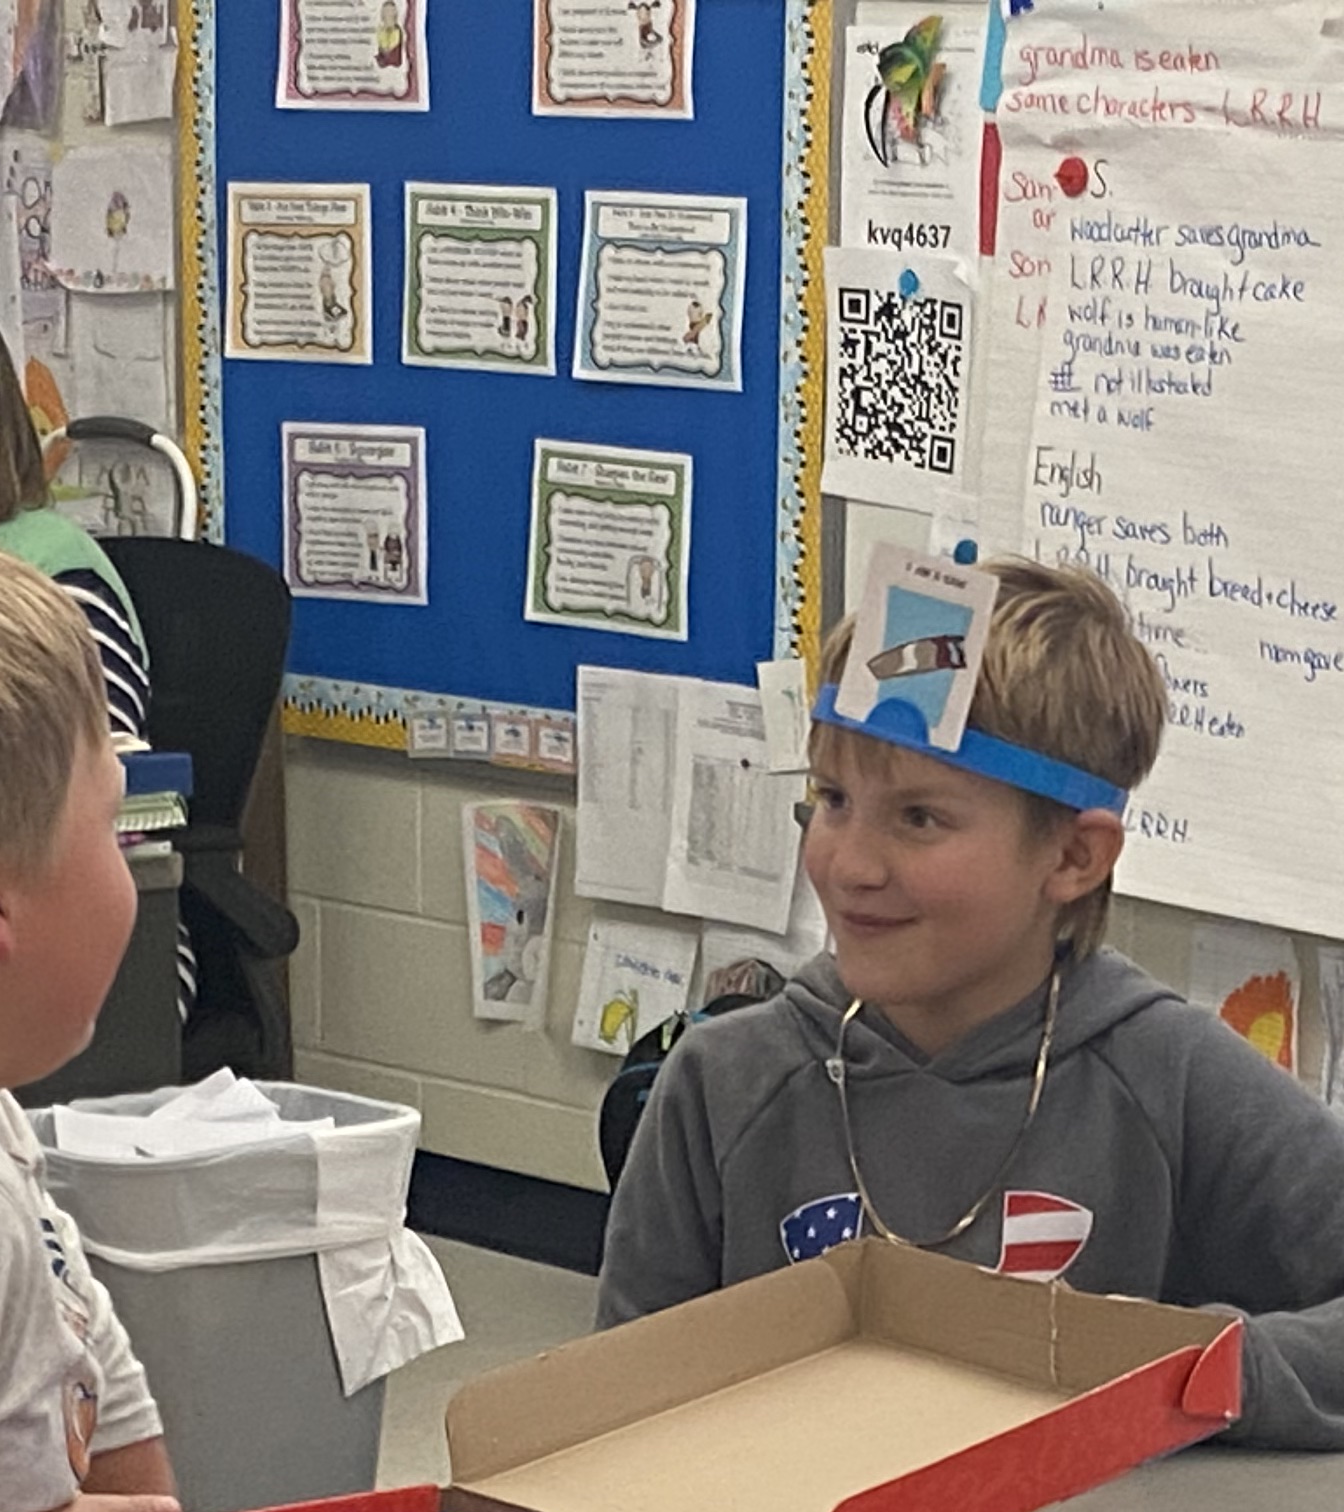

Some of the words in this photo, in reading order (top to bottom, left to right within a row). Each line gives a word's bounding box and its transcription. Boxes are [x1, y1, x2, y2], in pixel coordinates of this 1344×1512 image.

[1019, 33, 1124, 87] grandma
[1134, 48, 1156, 71] is
[1158, 44, 1222, 75] eaten
[1006, 89, 1070, 114] same
[1076, 84, 1197, 124] characters
[866, 219, 951, 251] kvq4637
[1173, 222, 1226, 248] saves
[1225, 219, 1322, 266] grandma
[1168, 257, 1249, 316] brought
[1255, 273, 1306, 303] cake
[1068, 297, 1111, 327] wolf
[1117, 307, 1135, 329] is
[1050, 398, 1090, 424] met
[1096, 406, 1109, 424] a
[1033, 445, 1103, 498] English
[1111, 515, 1173, 545] saves
[1182, 510, 1230, 549] both
[1125, 553, 1199, 613] brought
